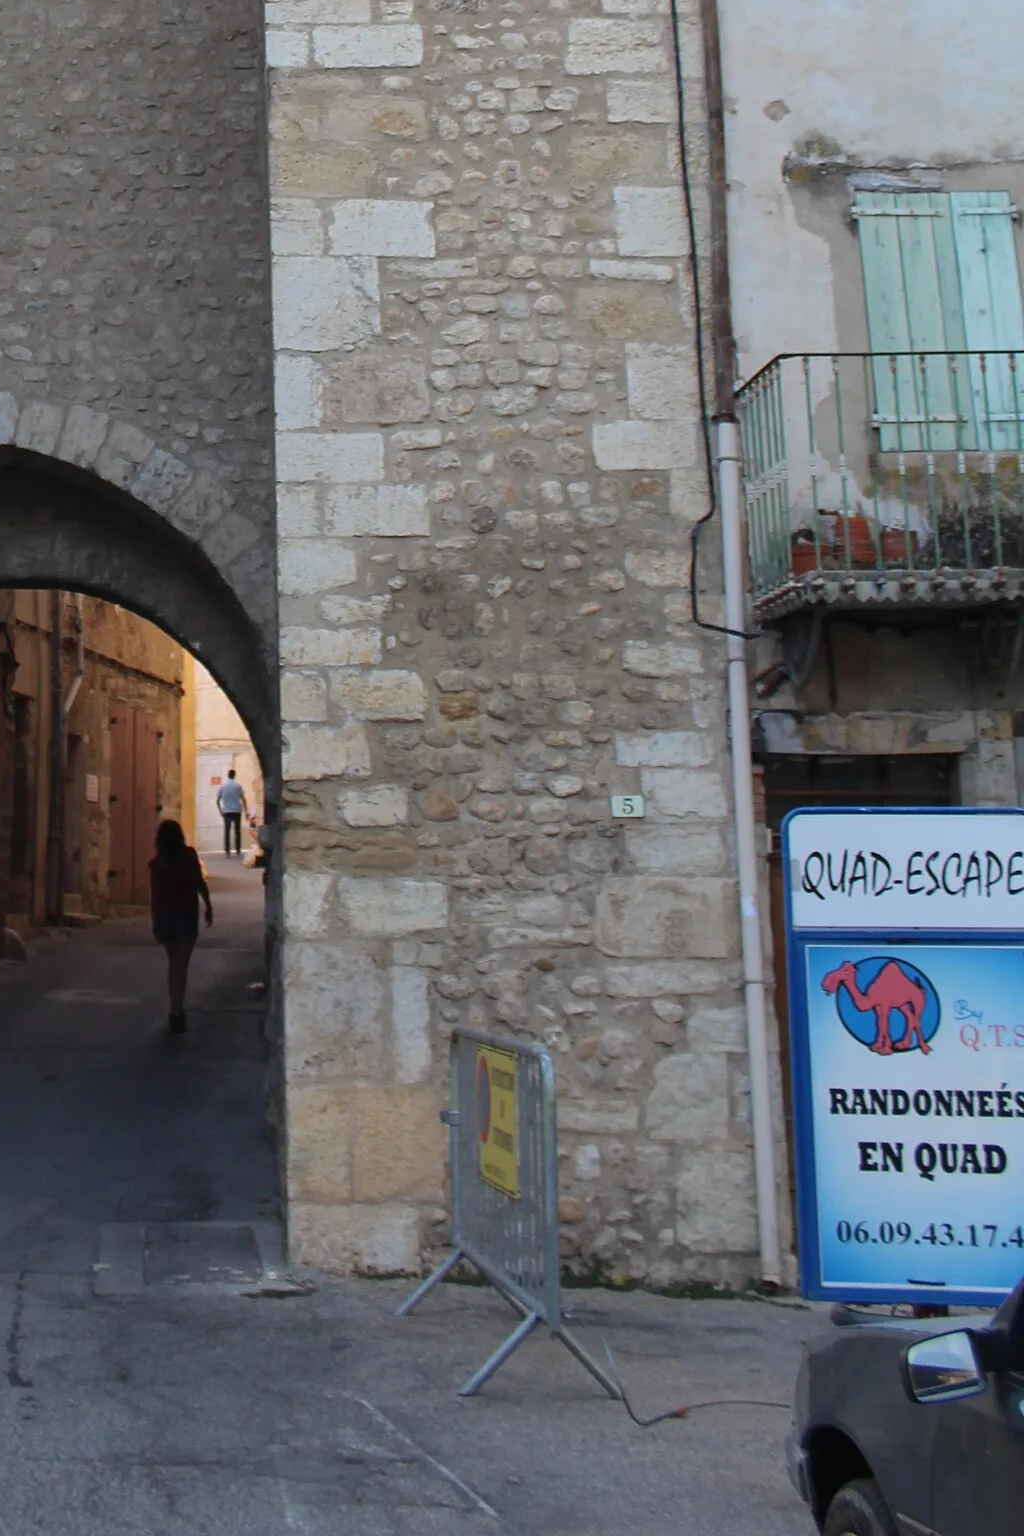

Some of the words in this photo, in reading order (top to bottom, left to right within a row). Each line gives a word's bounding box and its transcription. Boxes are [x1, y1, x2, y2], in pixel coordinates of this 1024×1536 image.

[622, 797, 635, 815] 5
[801, 848, 1024, 901] QUAD-ESCAPE
[953, 999, 984, 1024] By
[857, 1141, 905, 1173] EN
[913, 1141, 1008, 1182] QUAD
